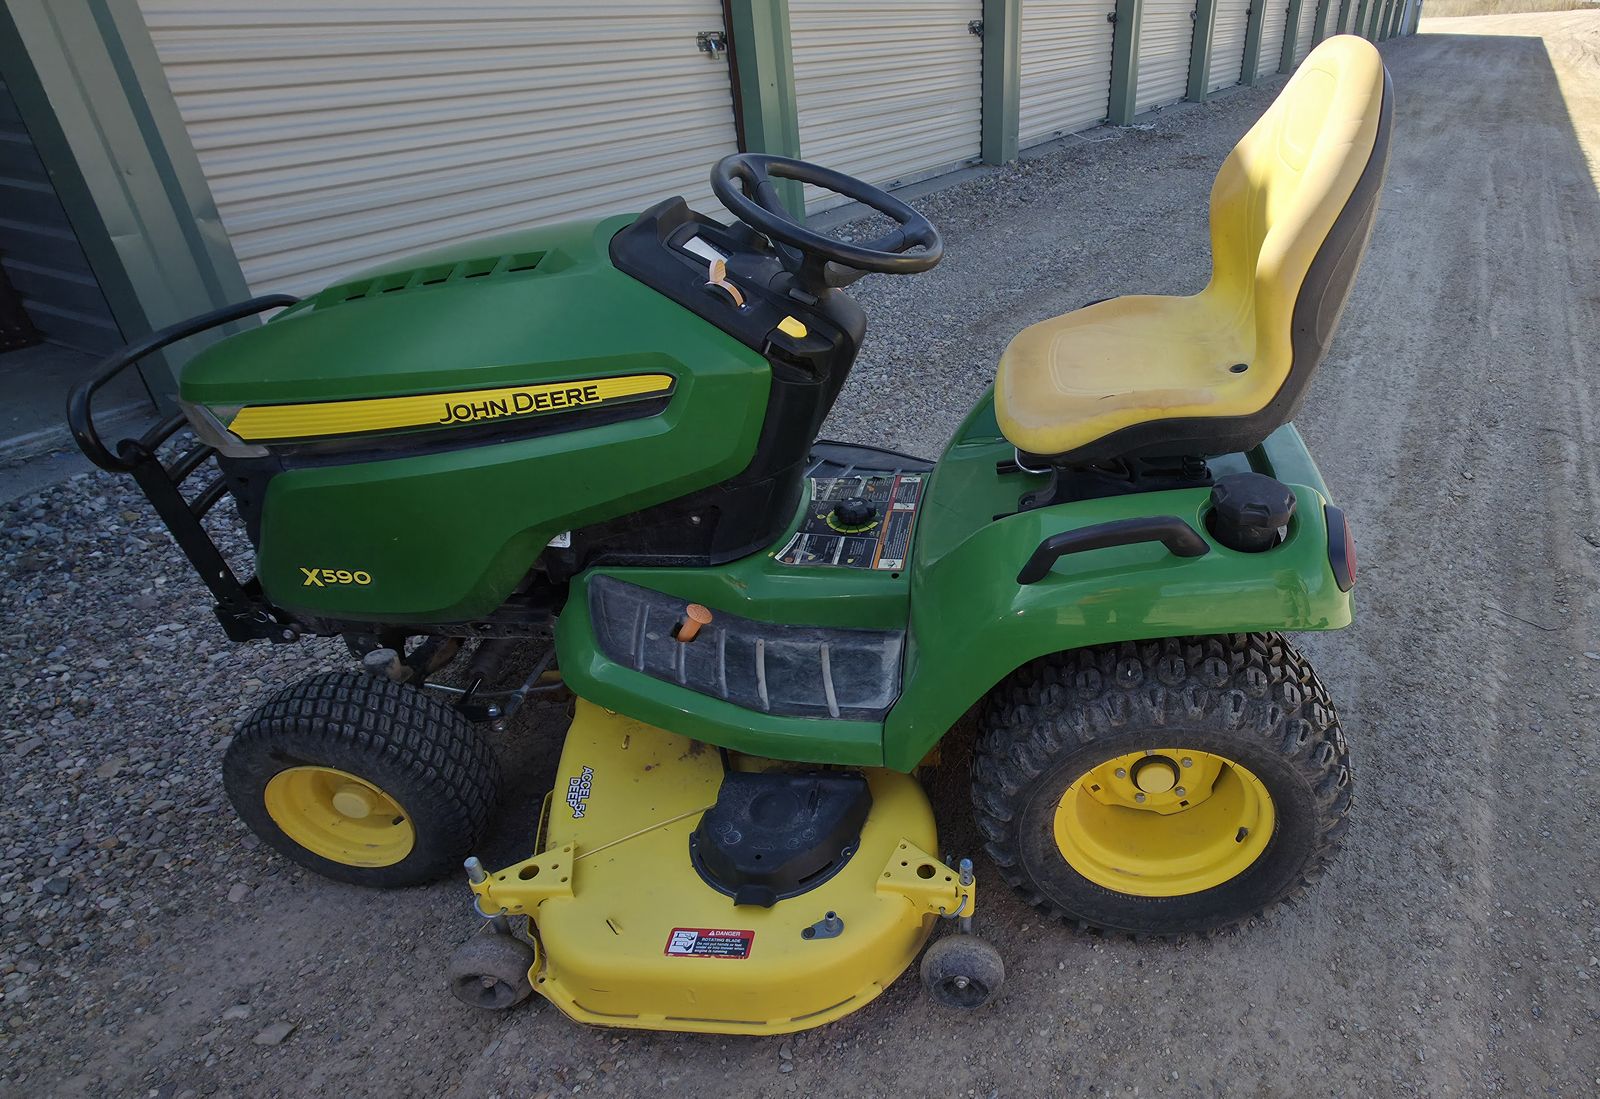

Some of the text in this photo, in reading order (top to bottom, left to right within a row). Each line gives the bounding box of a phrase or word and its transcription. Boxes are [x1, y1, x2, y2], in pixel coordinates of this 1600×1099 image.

[439, 385, 600, 423] JOHN DEERE
[299, 567, 372, 587] X590
[567, 778, 581, 807] DEEP
[573, 766, 594, 818] ACCEL 54
